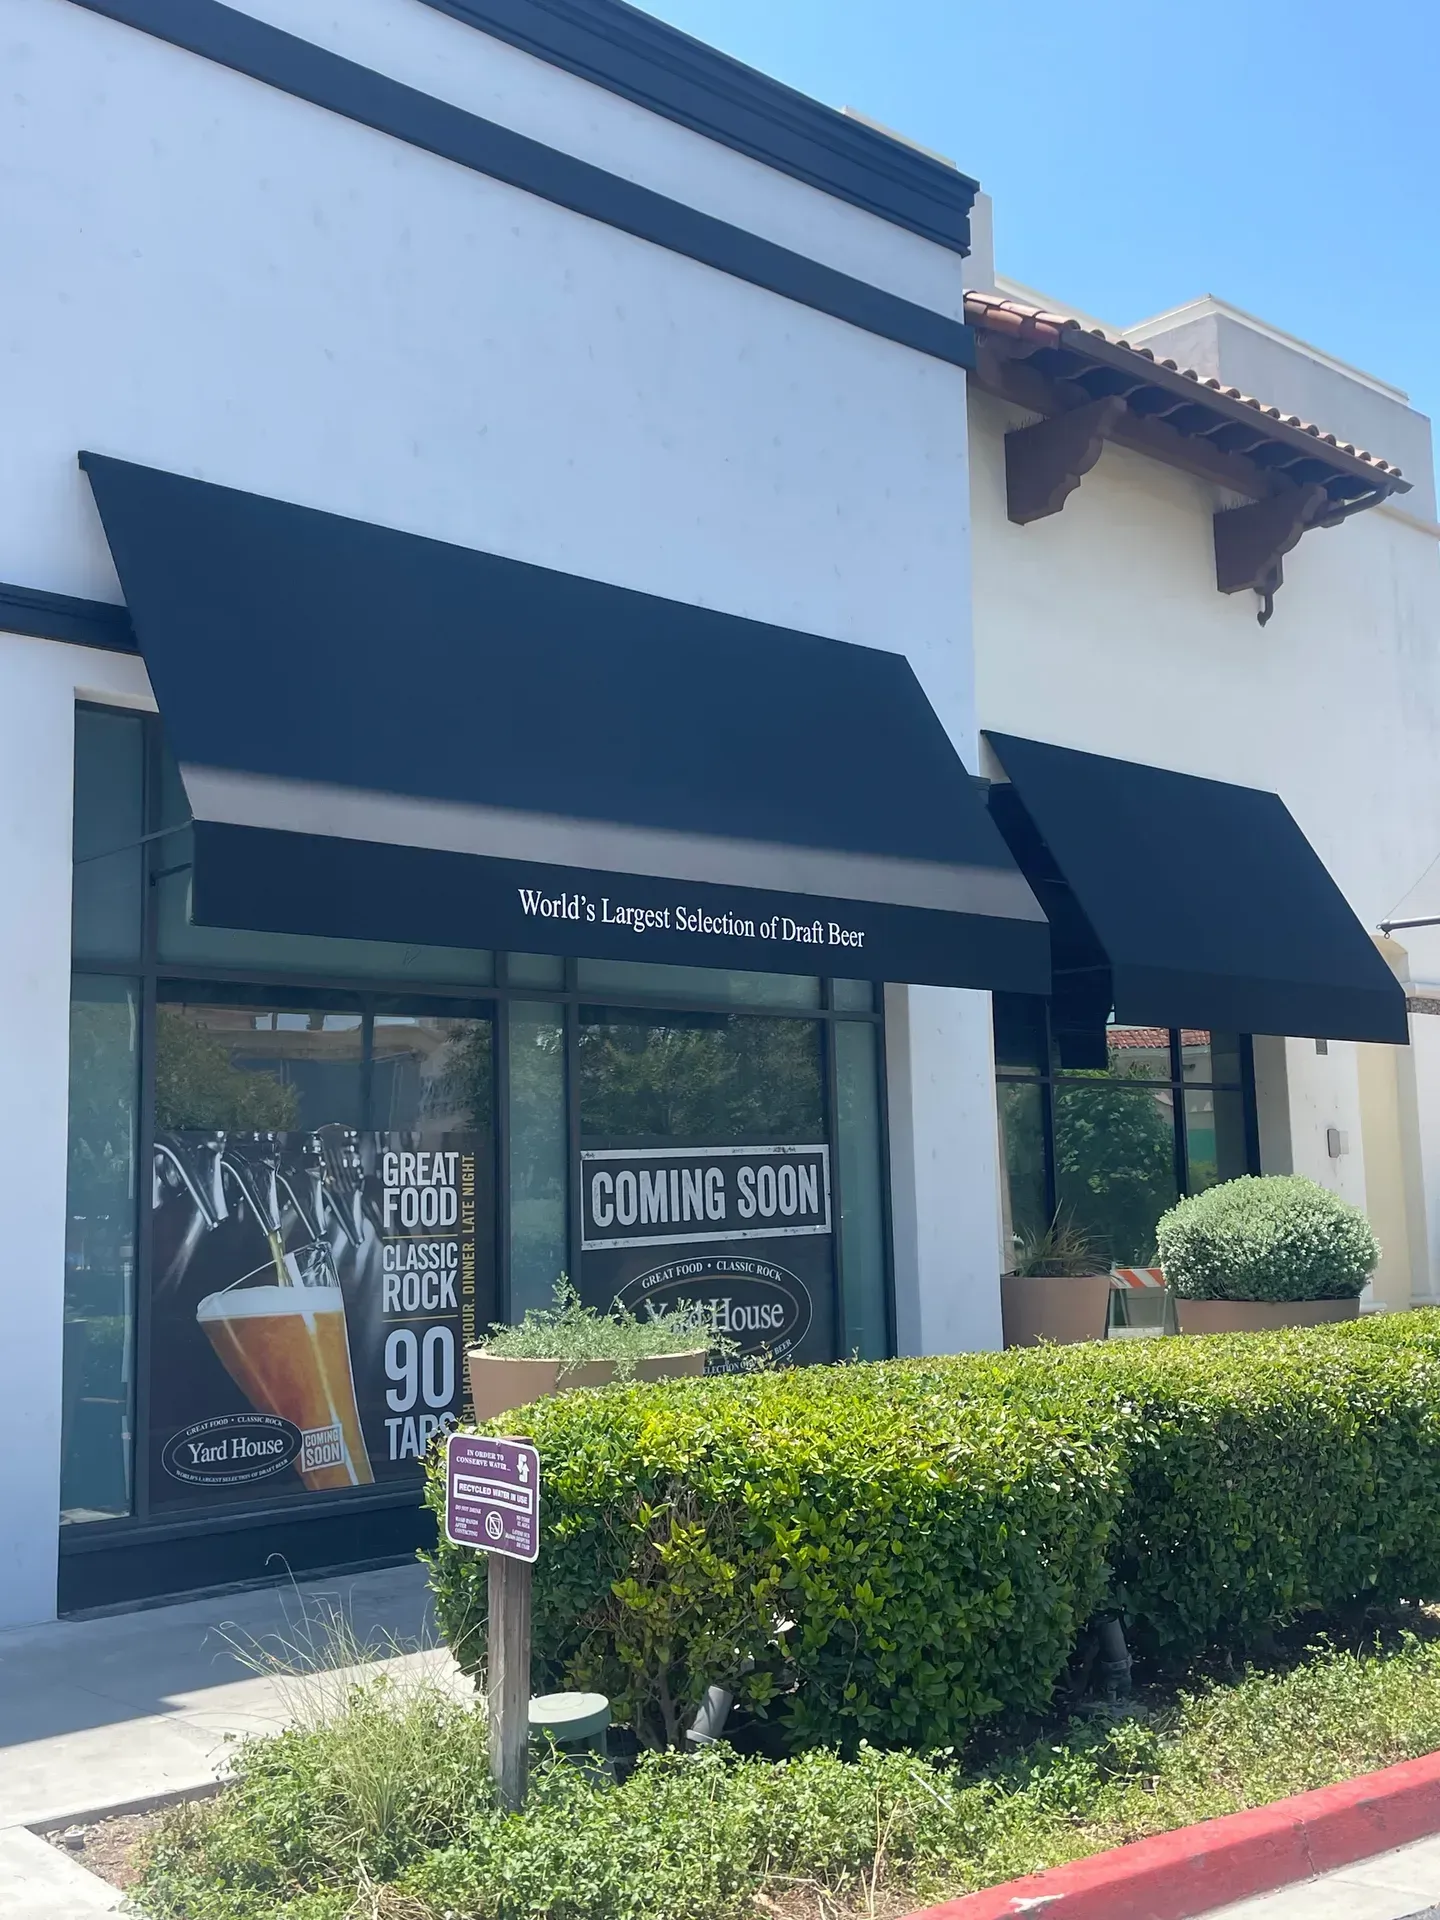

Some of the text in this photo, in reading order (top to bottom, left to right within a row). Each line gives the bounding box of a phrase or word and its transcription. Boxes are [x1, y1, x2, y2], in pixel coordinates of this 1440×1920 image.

[518, 888, 866, 948] World's Largest Selection of Draft Beer
[383, 1151, 459, 1187] GREAT
[462, 1151, 475, 1197] NIGHT.
[383, 1187, 458, 1228] FOOD
[591, 1164, 819, 1228] COMING SOON
[462, 1201, 475, 1234] LATE
[383, 1241, 458, 1272] CLASSIC
[462, 1238, 475, 1295] DINNER.
[641, 1260, 782, 1289] GREAT FOOD CLASSIC ROCK
[383, 1270, 458, 1313] ROCK
[462, 1298, 475, 1342] HOUR.
[709, 1297, 785, 1333] House
[384, 1325, 455, 1413] 90
[702, 1361, 740, 1375] ELECTION
[774, 1338, 792, 1355] BEER
[186, 1423, 209, 1436] GREAT
[209, 1418, 228, 1428] FOOD
[264, 1418, 283, 1427] ROCK
[305, 1429, 339, 1447] COMING
[187, 1437, 284, 1464] Yard House
[306, 1442, 340, 1466] SOON
[456, 1456, 488, 1467] CONSERVE
[467, 1449, 504, 1461] IN ORDER TO
[459, 1482, 528, 1505] RECYCLED WATER IN USE
